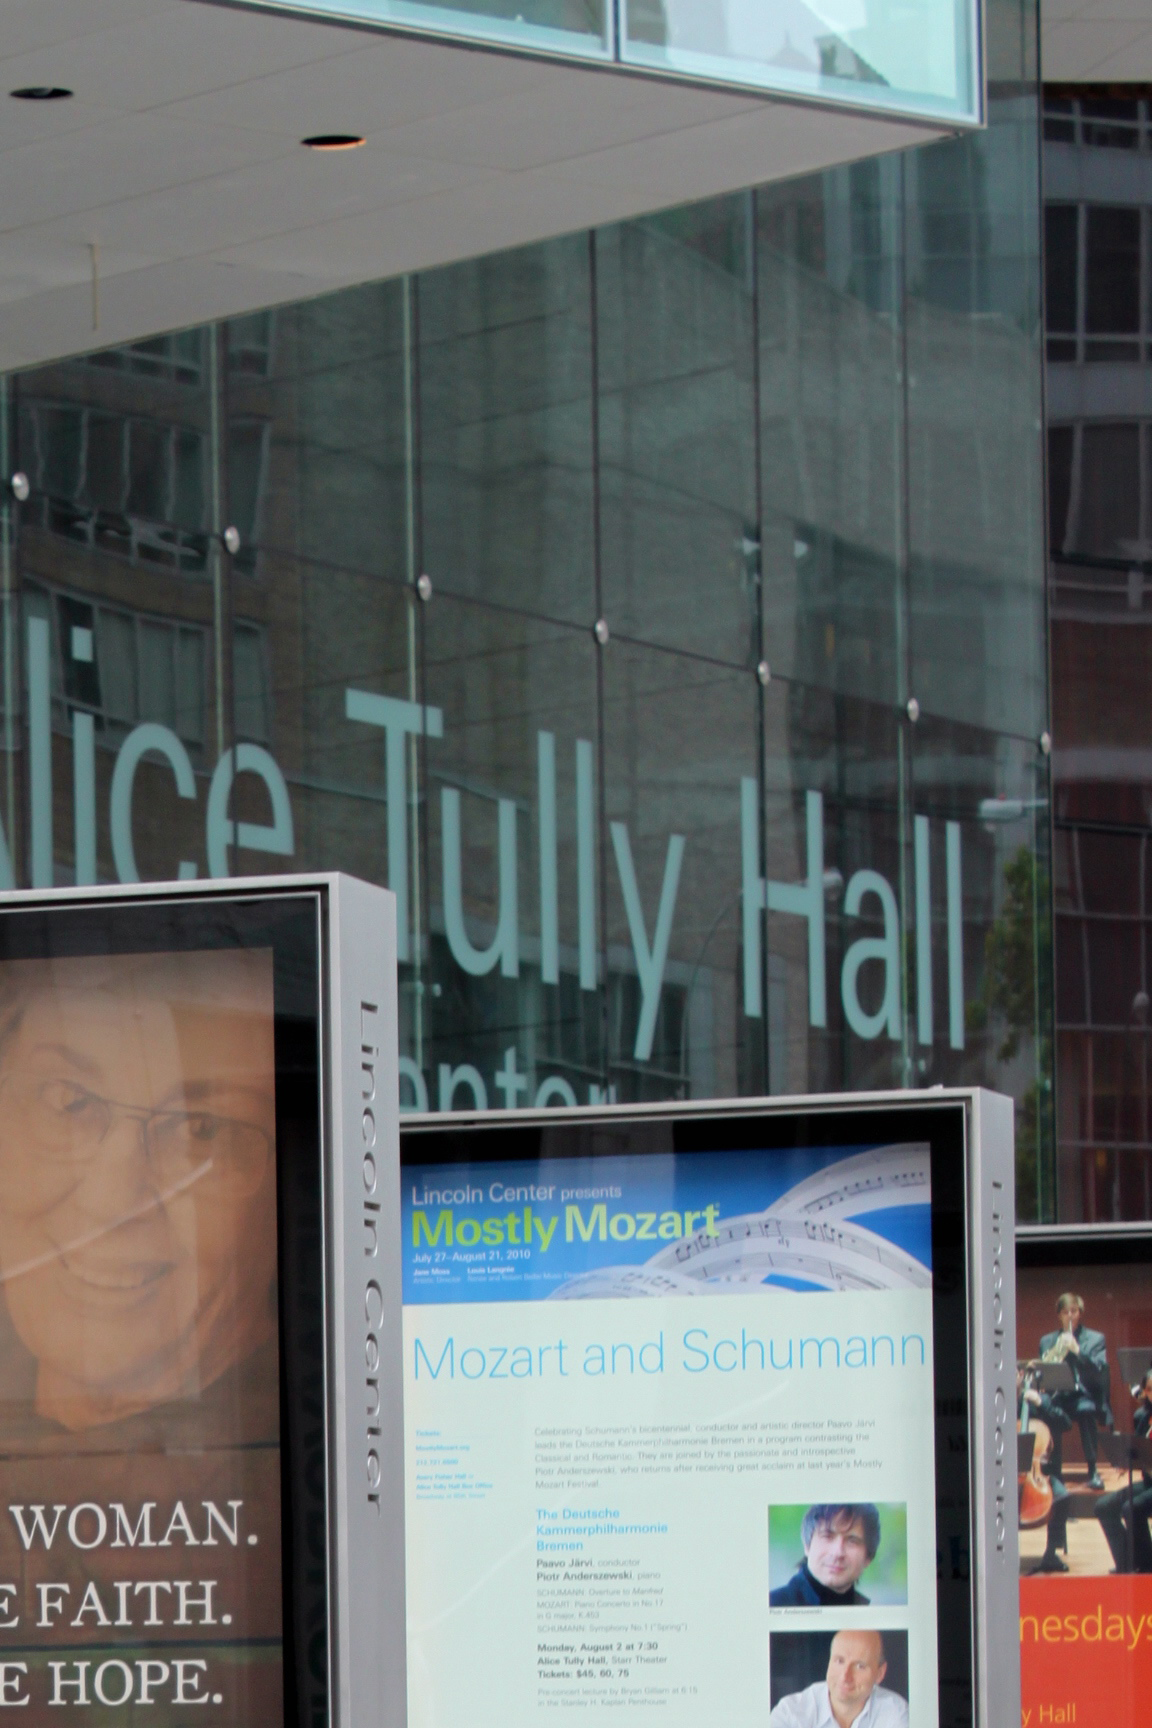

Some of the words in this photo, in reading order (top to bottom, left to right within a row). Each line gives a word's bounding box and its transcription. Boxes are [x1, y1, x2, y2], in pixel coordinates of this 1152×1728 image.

[345, 687, 685, 1060] Tully
[741, 777, 964, 1049] Hall
[360, 1002, 381, 1258] Lincoln
[412, 1185, 483, 1206] Lincoln
[489, 1183, 555, 1202] Center
[560, 1186, 622, 1202] presents
[412, 1205, 559, 1253] Mostly
[565, 1203, 720, 1242] Mozart
[413, 1253, 431, 1264] July
[507, 1250, 530, 1260] 2010
[992, 1181, 1005, 1372] Lincoln
[413, 1338, 568, 1381] Mozart
[583, 1331, 665, 1375] and
[682, 1328, 926, 1373] Schumann
[365, 1279, 384, 1518] Center
[994, 1387, 1007, 1566] Center
[8, 1500, 257, 1549] WOMAN.
[535, 1508, 558, 1520] The
[562, 1507, 619, 1519] Deutsche
[536, 1523, 668, 1538] Kammerphilharmonie
[536, 1540, 583, 1551] Bremen
[35, 1580, 231, 1627] FAITH.
[47, 1658, 222, 1705] HOPE.
[1040, 1703, 1076, 1723] Hall
